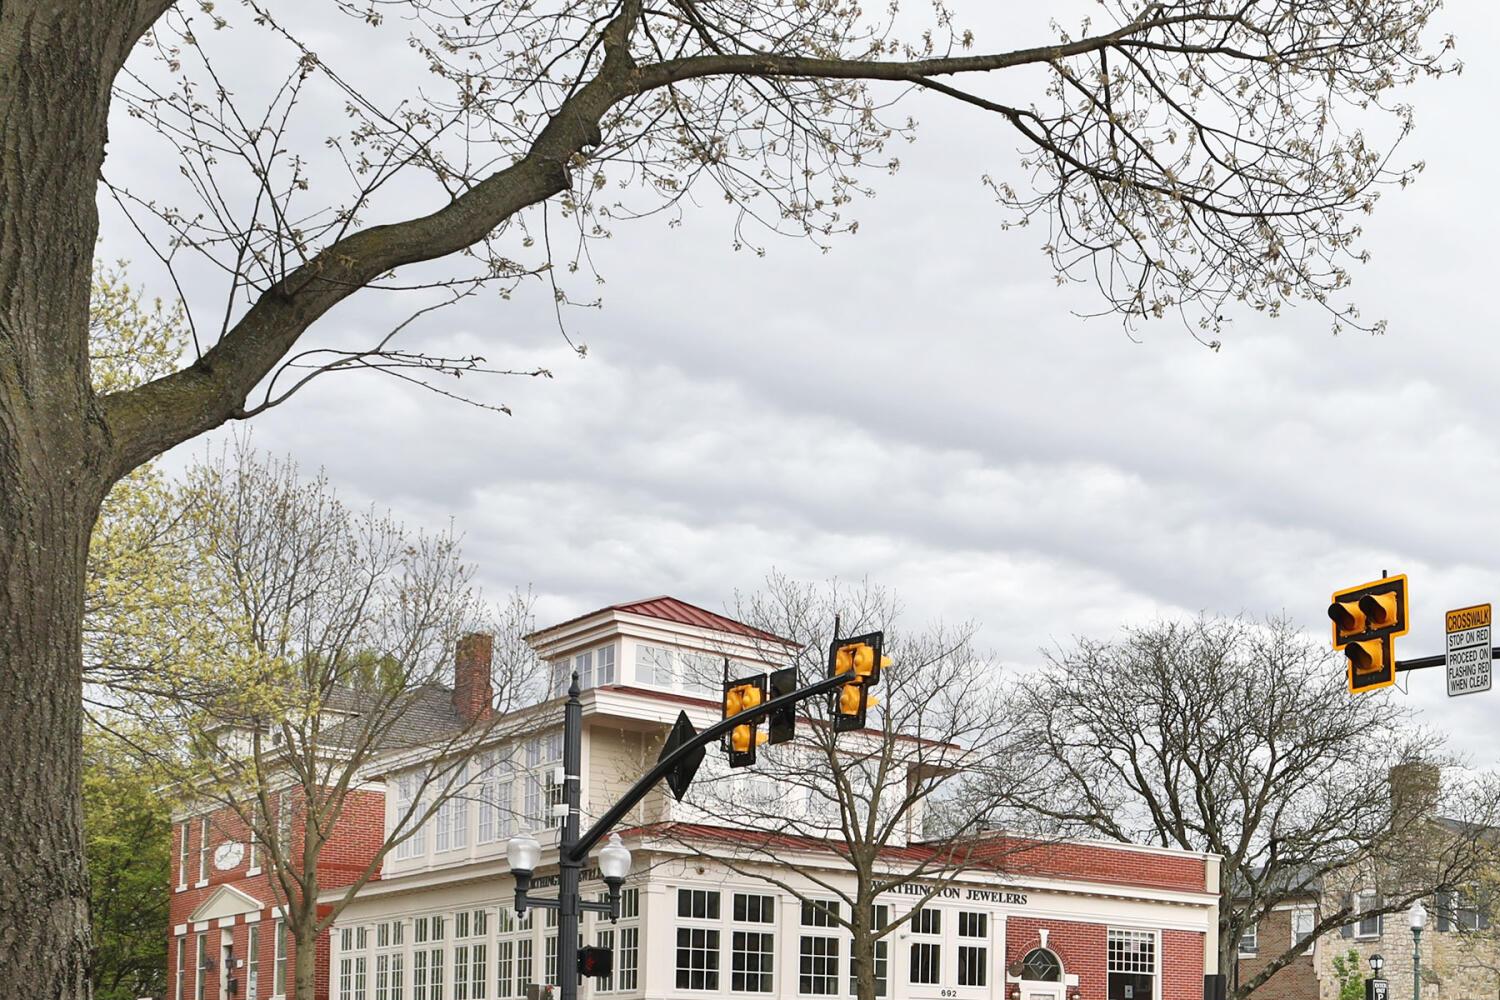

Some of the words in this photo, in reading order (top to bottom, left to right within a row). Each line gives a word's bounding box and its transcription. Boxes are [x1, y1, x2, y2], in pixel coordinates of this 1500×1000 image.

[1447, 610, 1489, 631] CROSSWALK
[1449, 633, 1464, 647] STOP
[1466, 631, 1474, 644] ON
[1476, 628, 1488, 641] RED
[1450, 650, 1478, 666] PROCEED
[1480, 647, 1488, 660] ON
[1449, 664, 1476, 679] FLASHING
[1478, 662, 1489, 674] RED
[1450, 678, 1468, 692] WHEN
[1469, 674, 1488, 689] CLEAR
[871, 880, 960, 900] WRTHINGTON
[966, 890, 1028, 904] JEWELERS
[941, 990, 957, 998] 692
